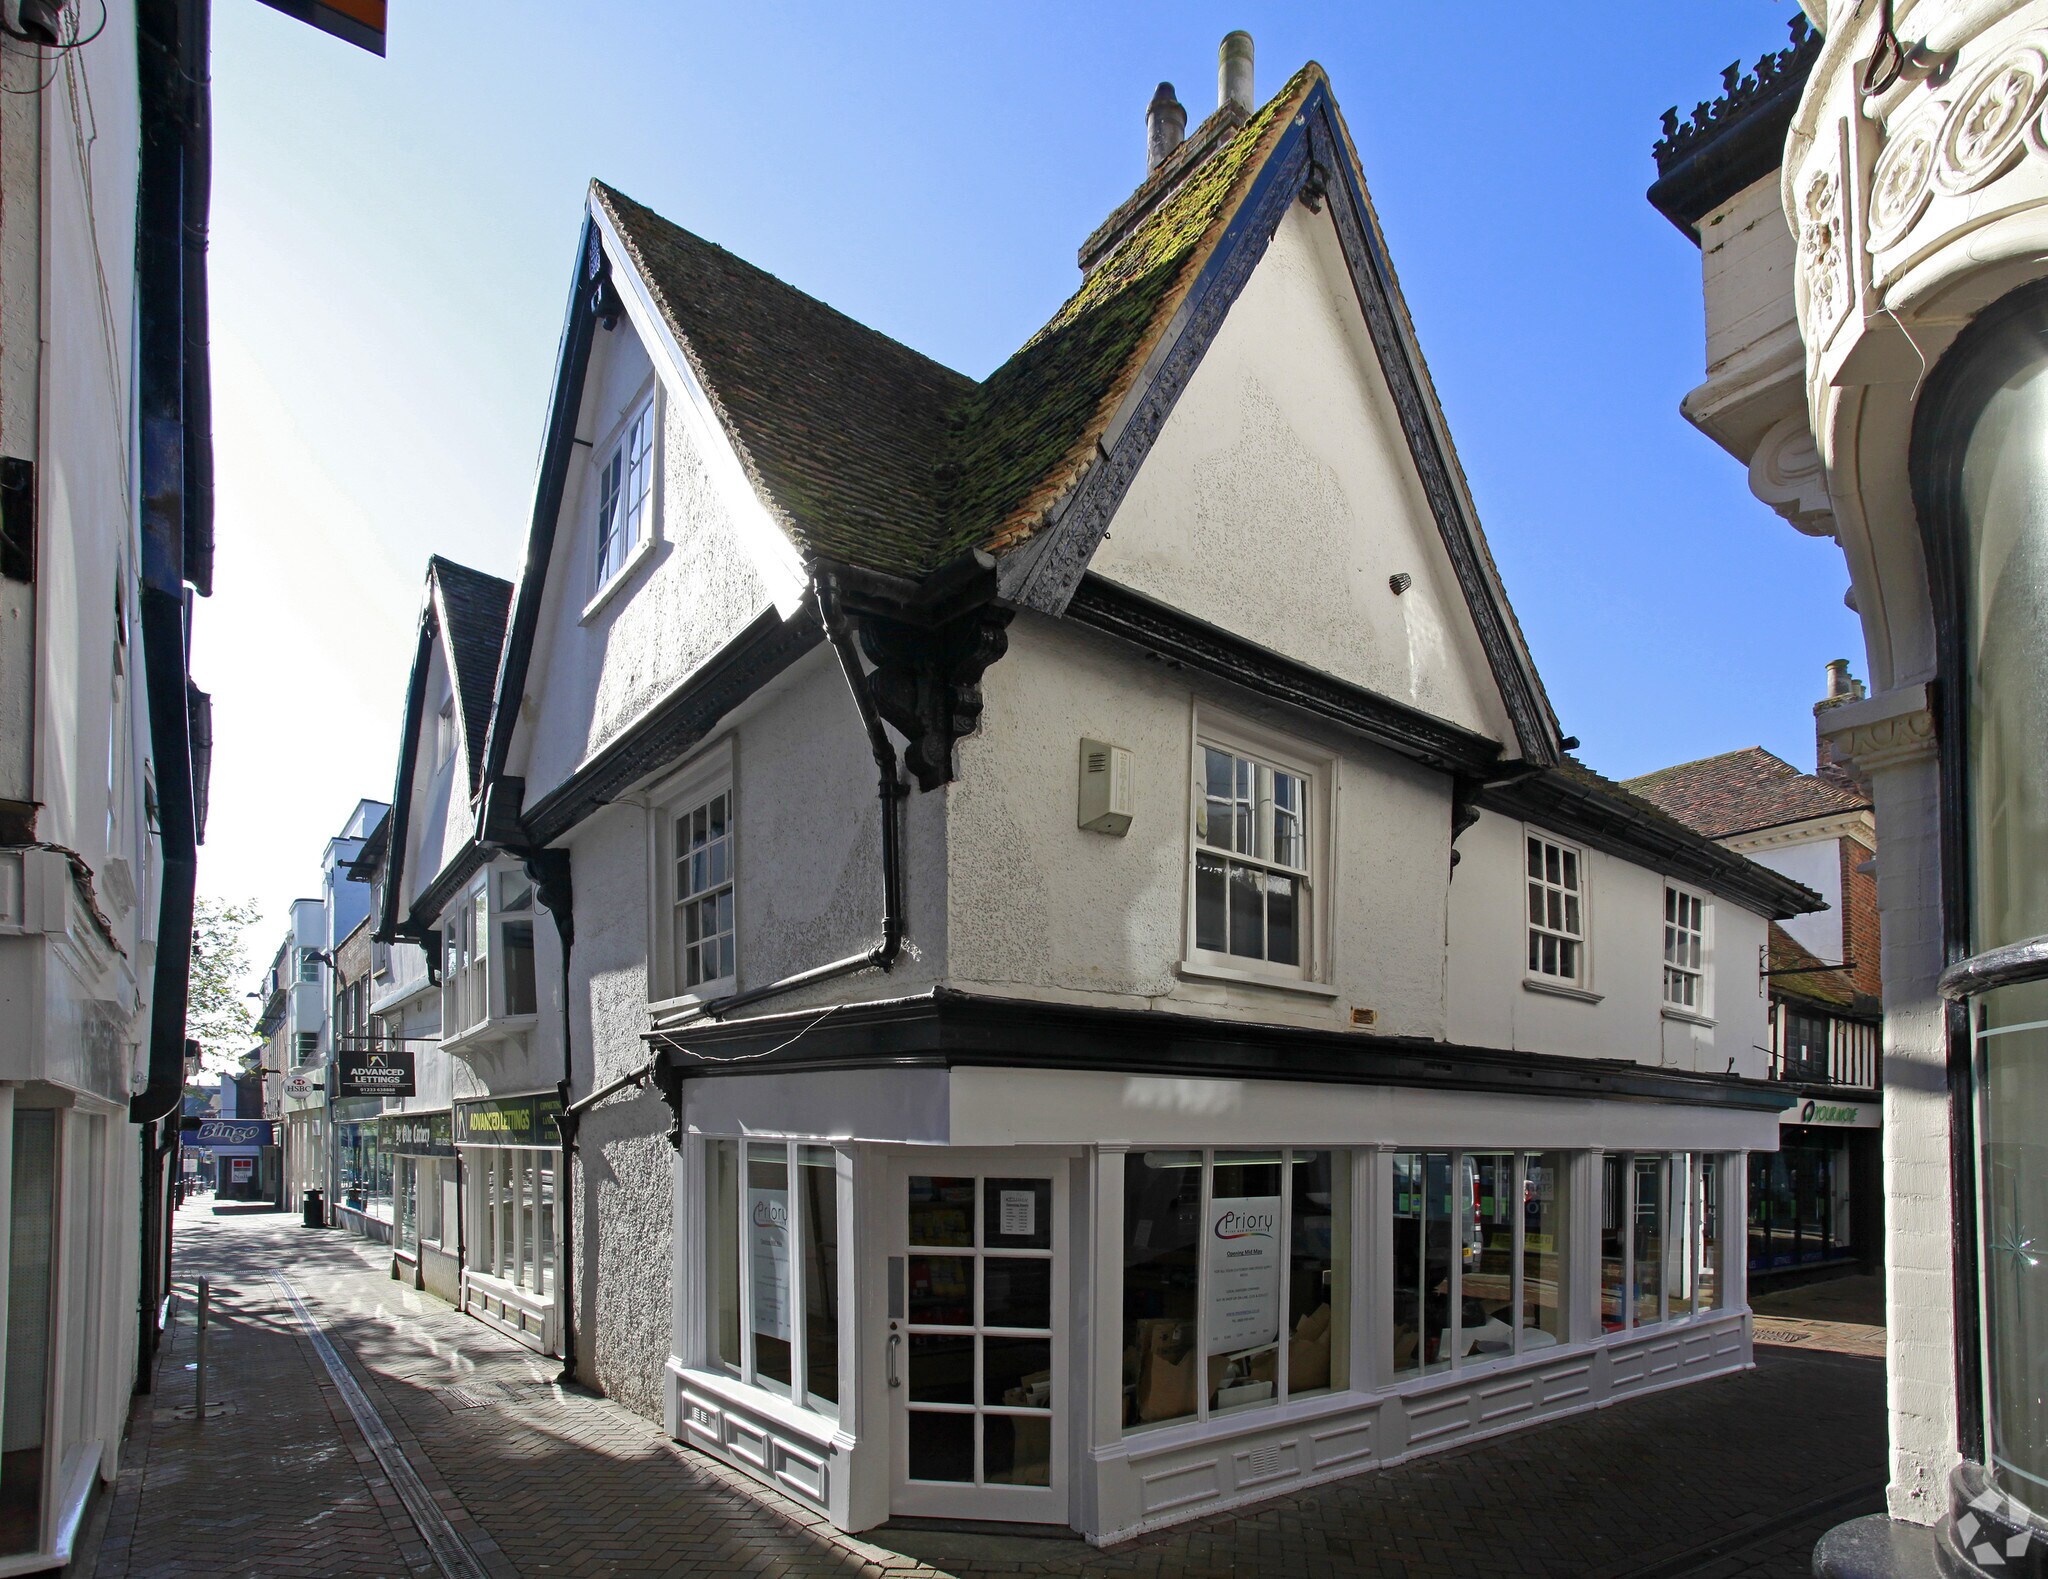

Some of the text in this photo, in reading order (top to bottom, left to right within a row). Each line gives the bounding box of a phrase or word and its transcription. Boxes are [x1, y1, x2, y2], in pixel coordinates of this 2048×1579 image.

[351, 1068, 404, 1076] ADVANCED
[470, 1111, 500, 1131] ADVANCED
[500, 1109, 530, 1130] LETTINGS
[1814, 1105, 1836, 1121] YOUR
[197, 1122, 259, 1143] Bingo
[757, 1201, 788, 1225] Priory
[1225, 1211, 1273, 1232] Priory
